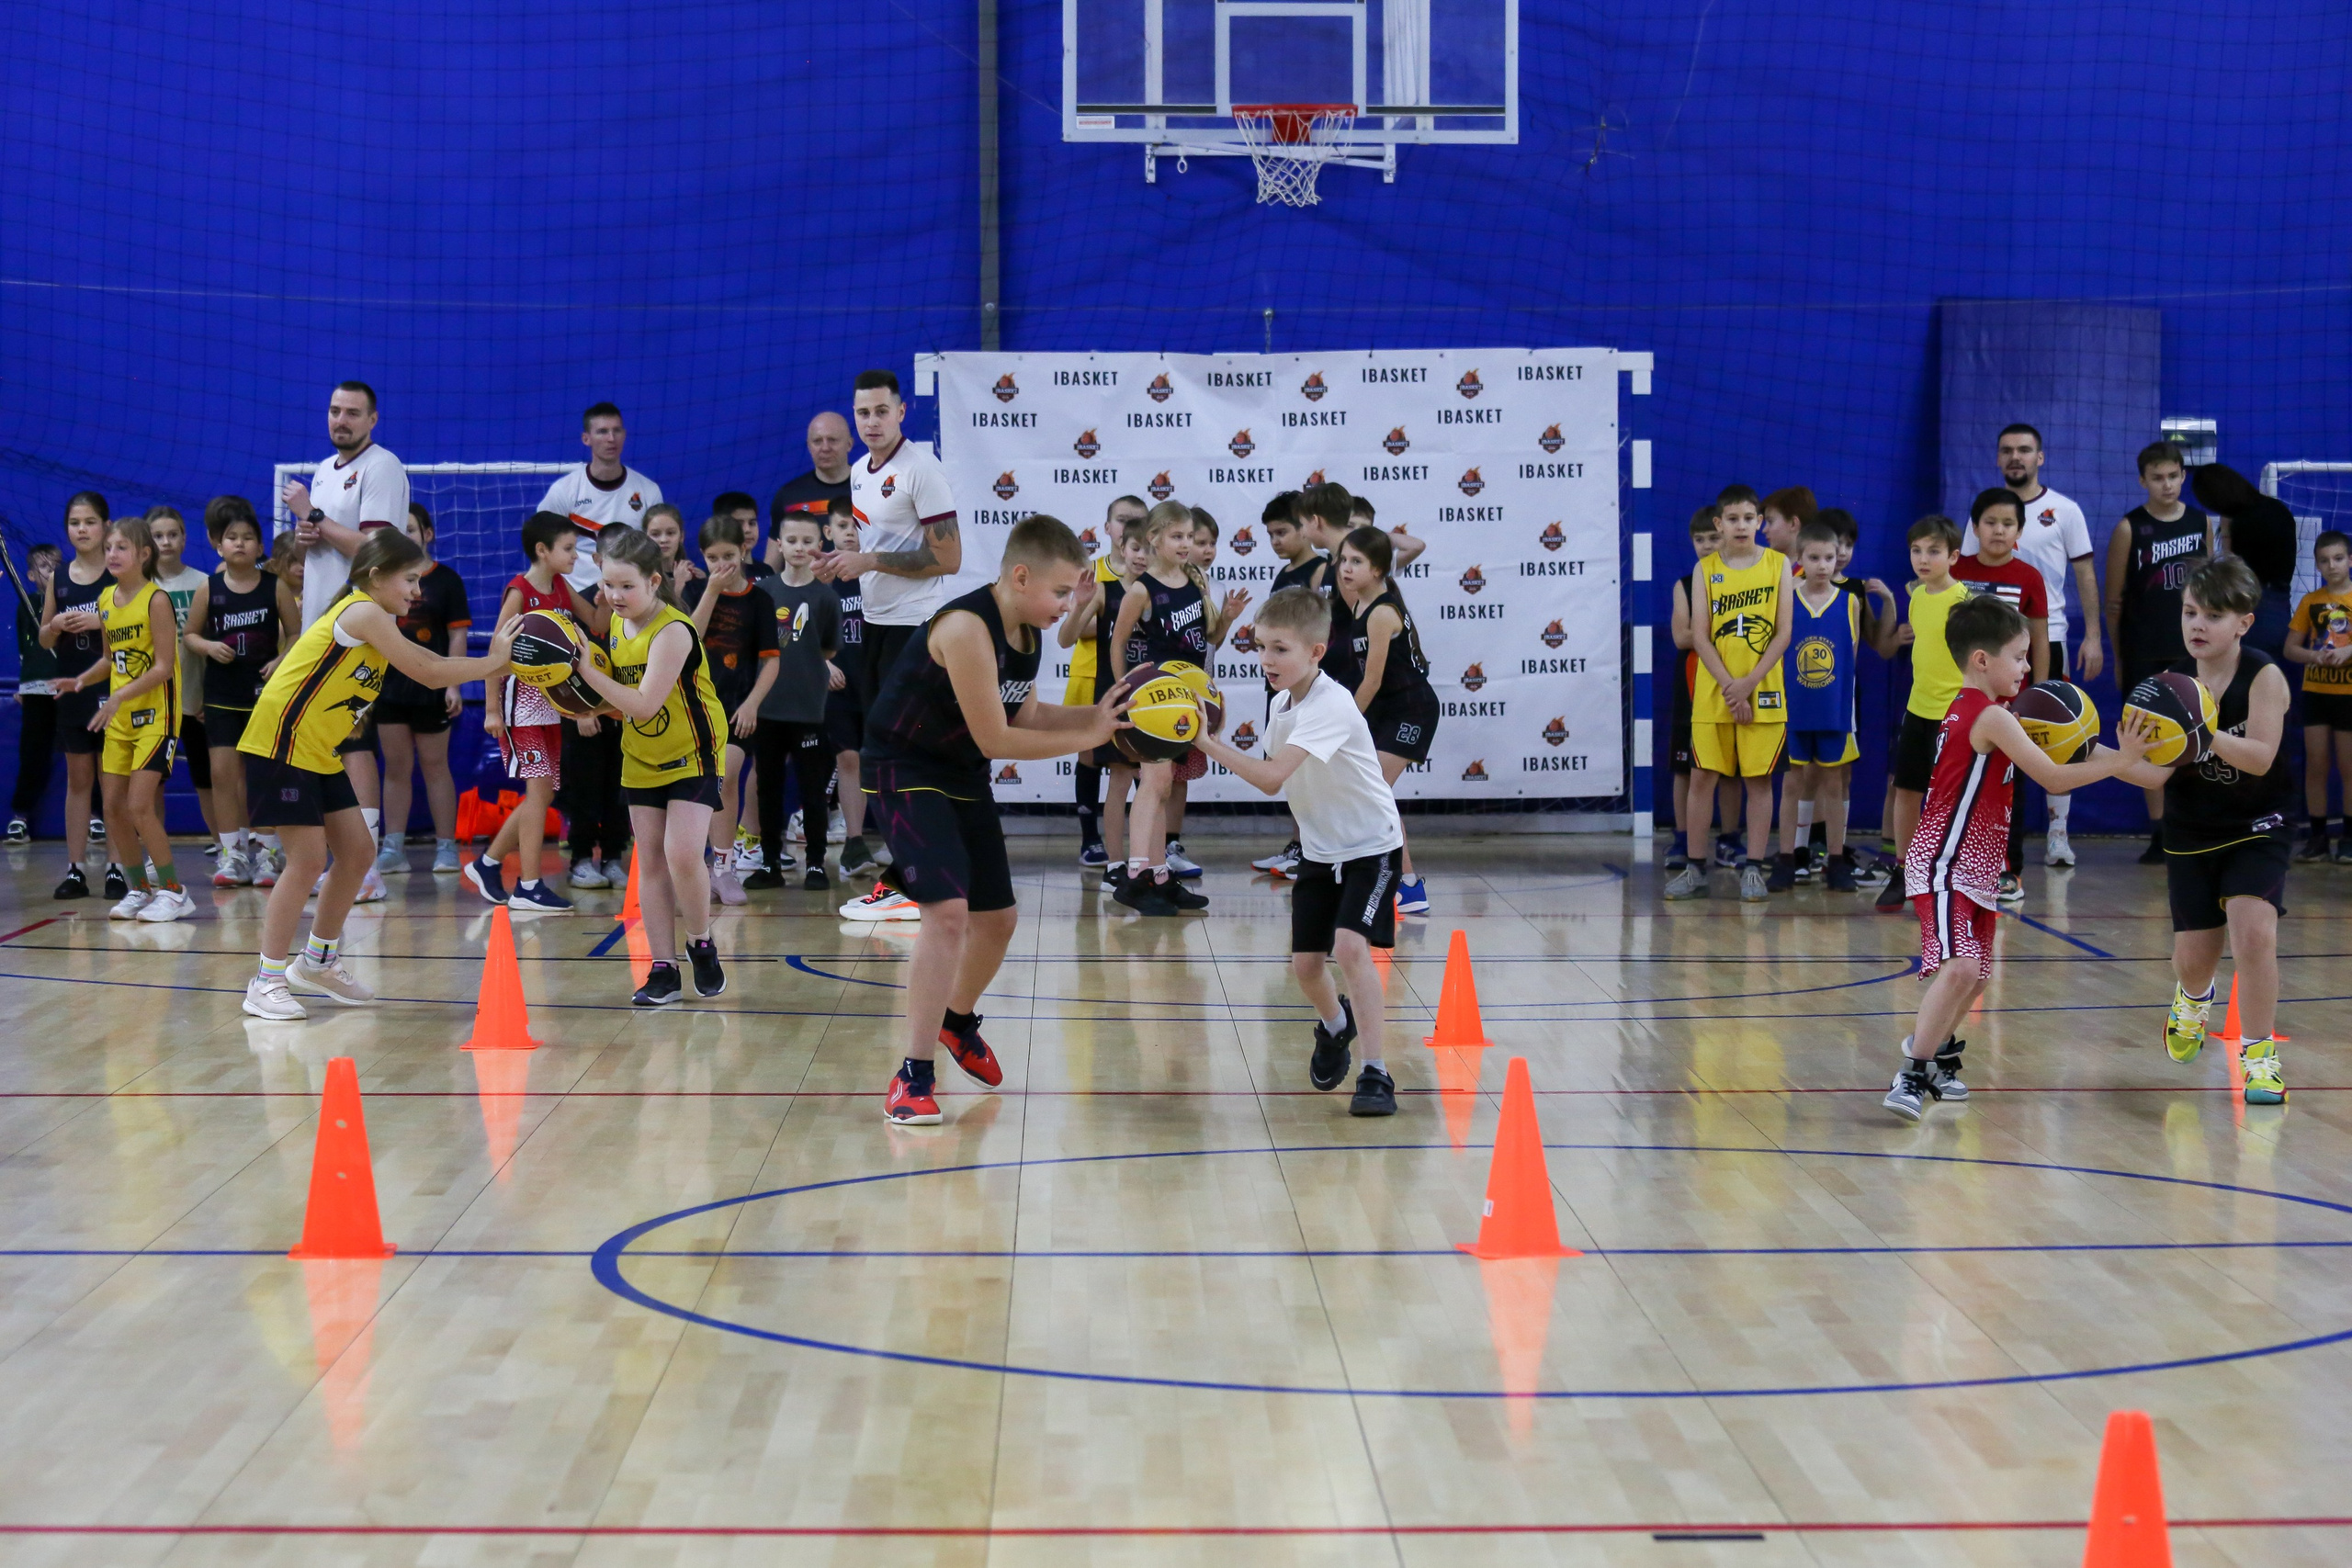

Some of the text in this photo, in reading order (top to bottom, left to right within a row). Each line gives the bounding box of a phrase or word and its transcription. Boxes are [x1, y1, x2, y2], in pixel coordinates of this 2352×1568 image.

[1054, 371, 1118, 386] IBASKET
[1207, 371, 1272, 388] IBASKET
[1362, 367, 1427, 383] IBASKET
[1518, 366, 1583, 381] IBASKET
[972, 412, 1037, 428] IBASKET
[1127, 412, 1193, 428] IBASKET
[1282, 411, 1347, 427] IBASKET
[1437, 409, 1502, 424] IBASKET
[1054, 468, 1118, 484] IBASKET
[1209, 468, 1274, 483] IBASKET
[1363, 465, 1429, 481] IBASKET
[1519, 463, 1584, 479] IBASKET
[1439, 506, 1503, 523] IBASKET
[2151, 533, 2202, 564] BASKET
[1209, 565, 1276, 581] IBASKET
[1520, 560, 1585, 577] IBASKET
[1718, 586, 1774, 616] BASKET
[223, 608, 269, 631] BASKET
[1170, 599, 1203, 632] BASKE
[1441, 604, 1505, 620] IBASKET
[1736, 613, 1744, 637] 1
[237, 632, 246, 656] 1
[1812, 648, 1827, 660] 30
[115, 650, 127, 675] 6
[1521, 658, 1587, 674] IBASKET
[1796, 674, 1836, 689] WARRIORS
[1148, 686, 1196, 705] IBASK
[1441, 701, 1507, 717] IBASKET
[1396, 722, 1421, 745] 28
[1522, 755, 1588, 772] IBASKET
